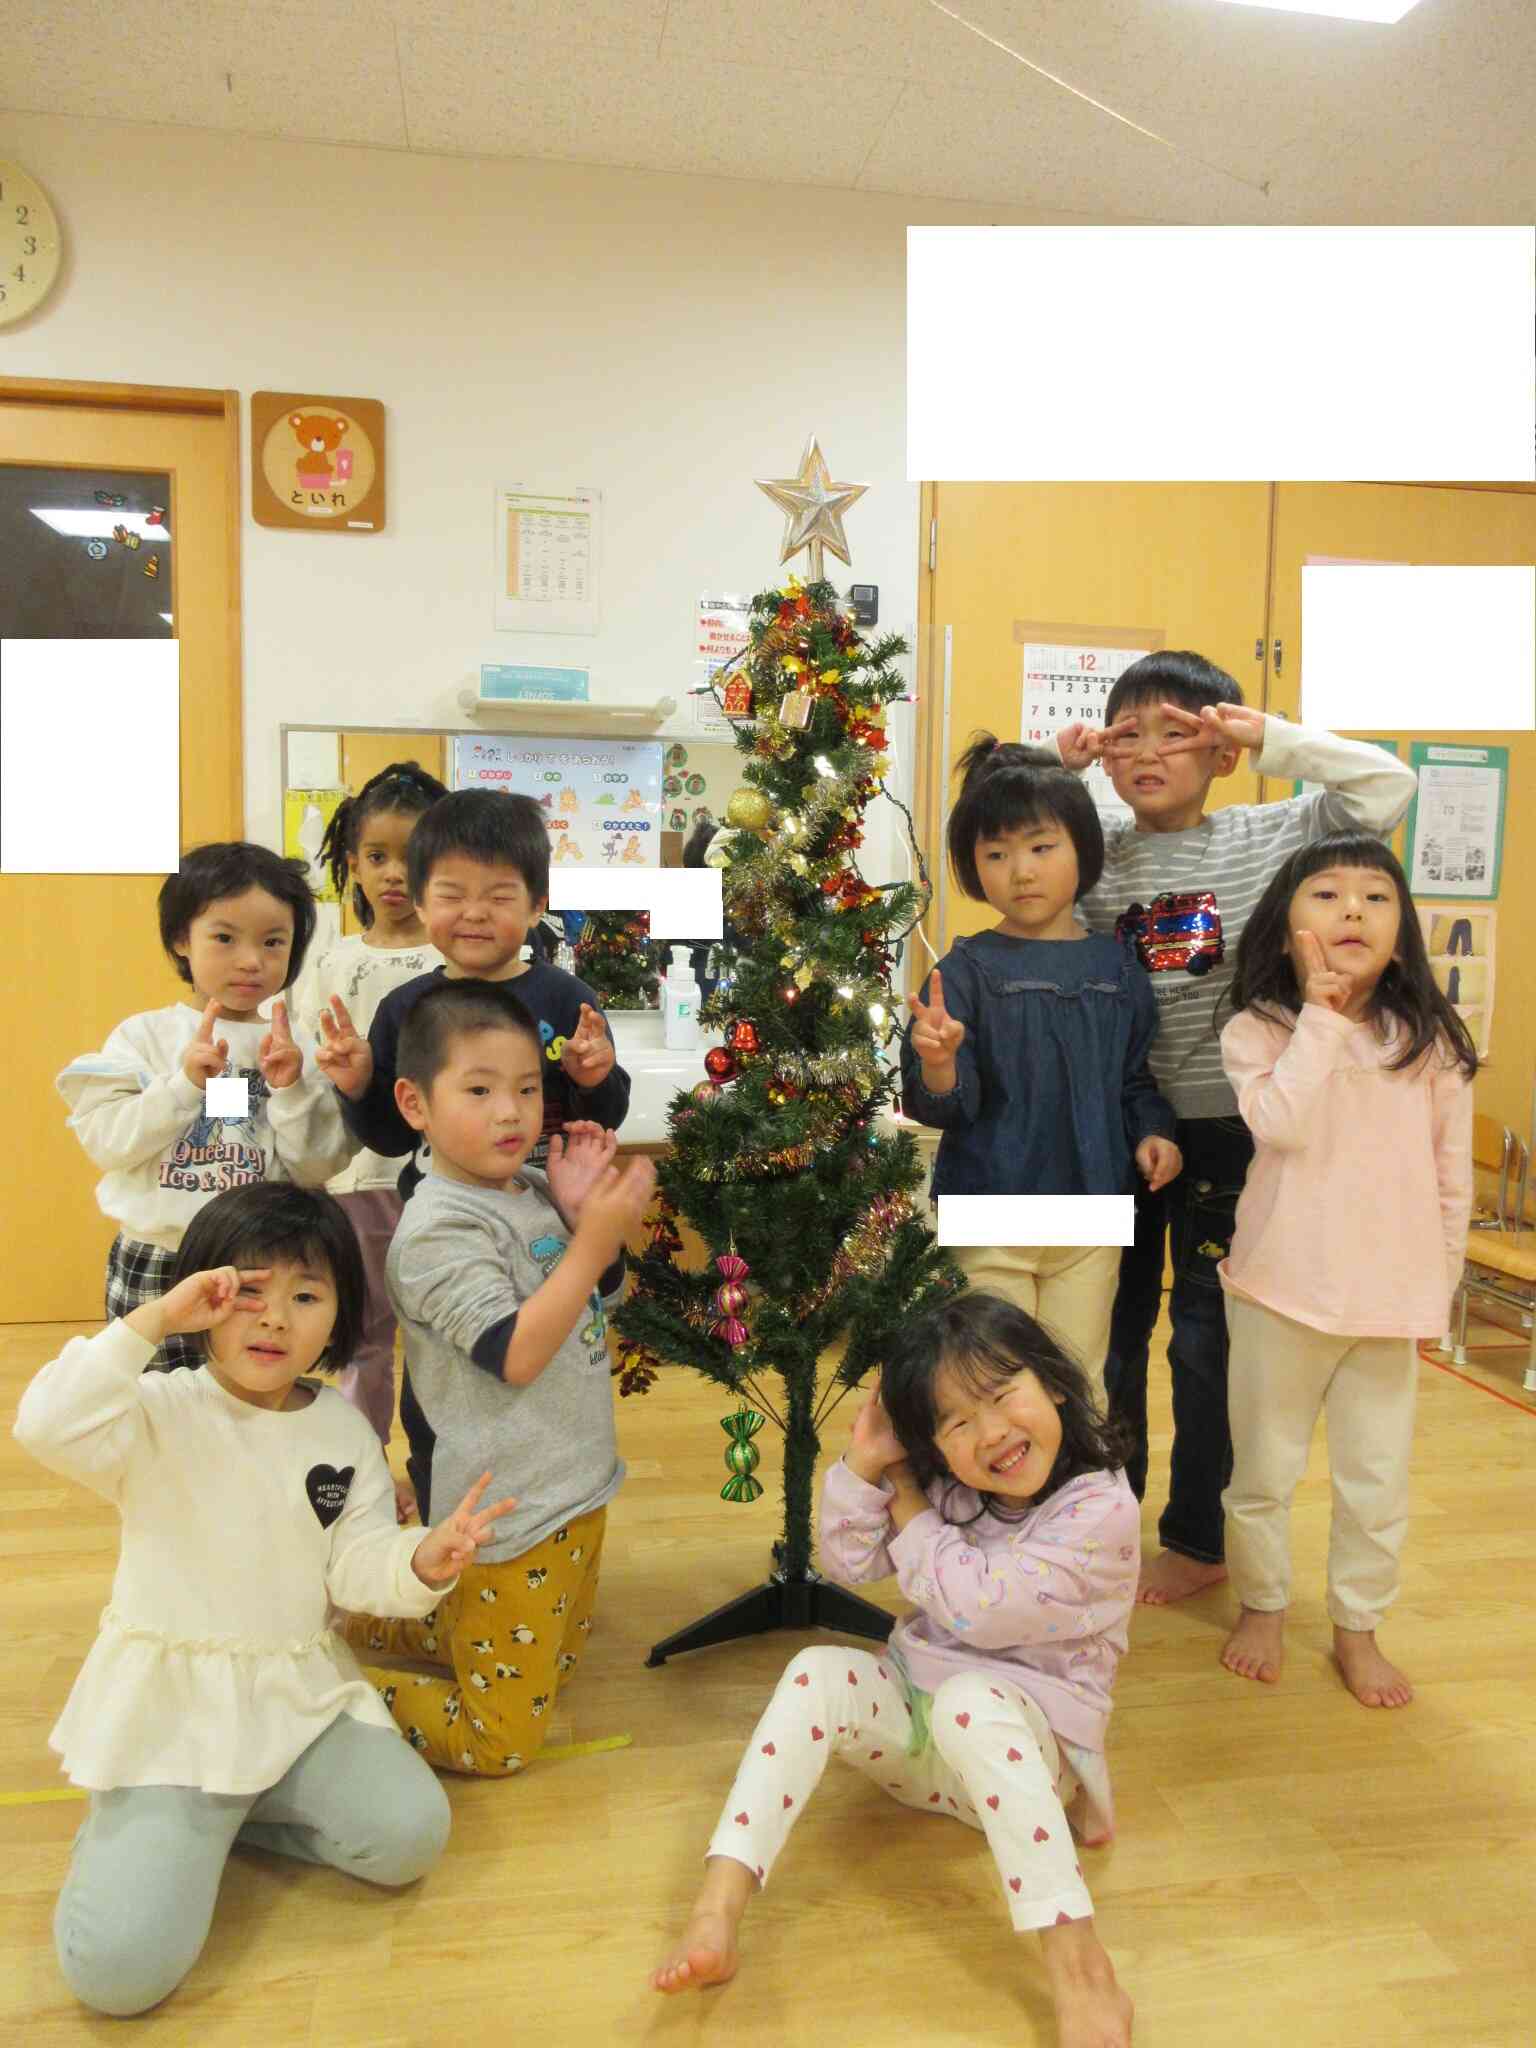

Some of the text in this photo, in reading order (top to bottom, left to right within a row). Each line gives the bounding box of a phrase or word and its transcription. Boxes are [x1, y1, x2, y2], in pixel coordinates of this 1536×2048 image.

[15, 205, 29, 226] 2
[24, 236, 37, 256] 3
[11, 263, 25, 282] 4
[291, 490, 347, 507] といれ
[1078, 654, 1097, 671] 12
[1050, 681, 1107, 694] 1 2 3 4
[1031, 705, 1039, 716] 7
[1048, 706, 1056, 717] 8
[1065, 706, 1073, 717] 9
[1080, 707, 1093, 718] 10
[1028, 729, 1041, 741] 14
[172, 1141, 248, 1169] Queen
[160, 1161, 199, 1191] Ice
[199, 1170, 217, 1191] &
